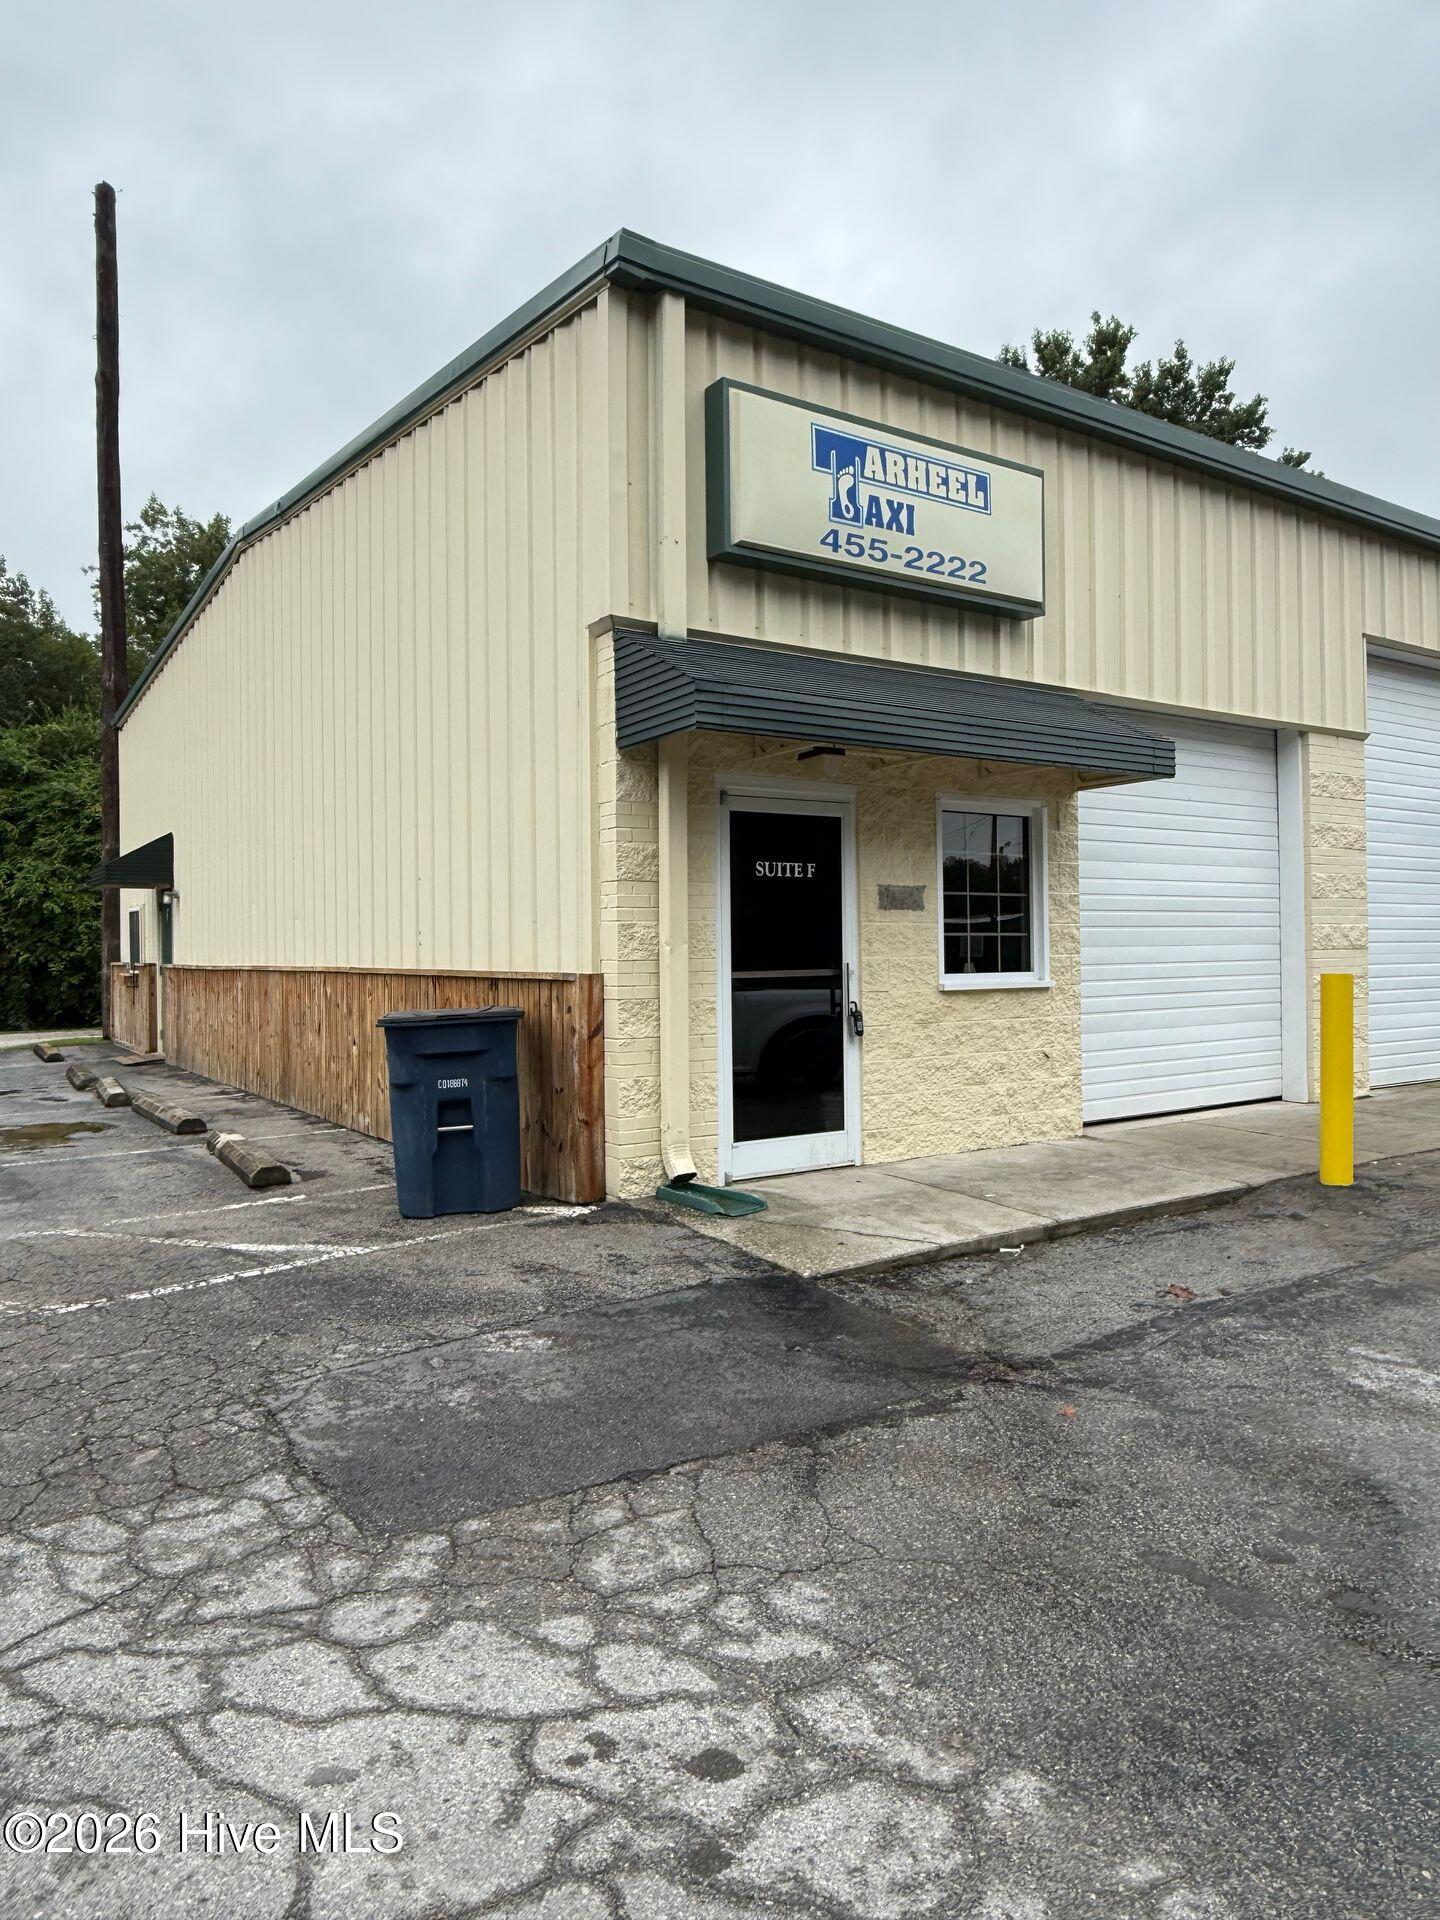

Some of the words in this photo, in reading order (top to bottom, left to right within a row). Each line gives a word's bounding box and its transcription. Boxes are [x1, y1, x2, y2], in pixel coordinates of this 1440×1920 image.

[820, 528, 987, 584] 455-2222
[755, 861, 803, 878] SUITE
[807, 863, 816, 878] F
